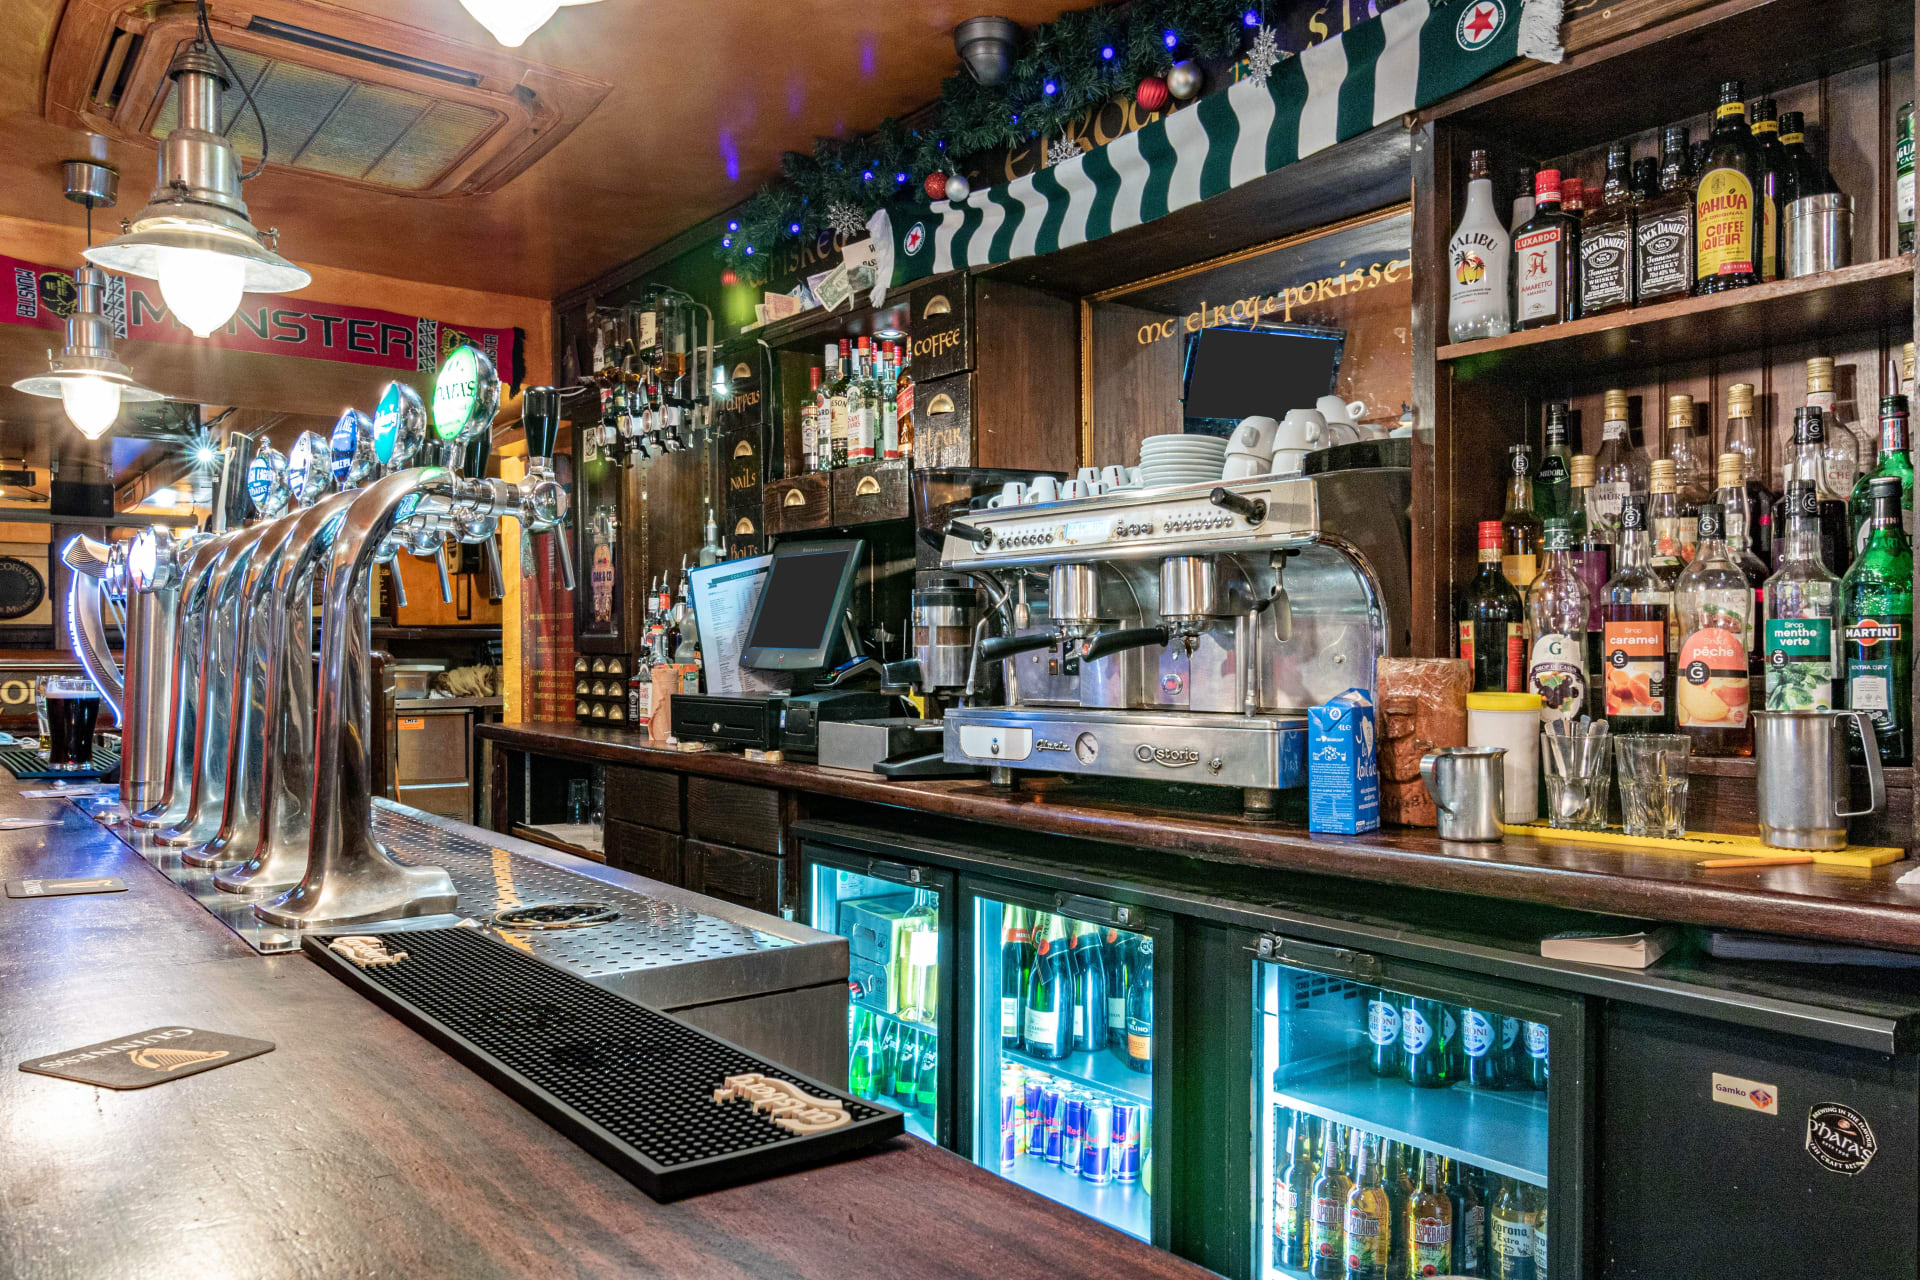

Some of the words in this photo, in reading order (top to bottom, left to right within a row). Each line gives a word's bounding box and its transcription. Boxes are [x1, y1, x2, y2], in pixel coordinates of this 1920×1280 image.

[1706, 221, 1744, 237] COFFEE
[1449, 232, 1498, 254] MALIBU
[1517, 232, 1557, 249] LUXARDO
[1639, 228, 1658, 246] JACK
[1581, 242, 1598, 260] JACK
[1646, 252, 1680, 264] Tennessee
[1646, 260, 1679, 272] WHISKEY
[1588, 274, 1618, 286] WHISKEY
[14, 266, 38, 318] MUNSTER
[1520, 280, 1552, 294] AMARETTO
[1263, 296, 1276, 315] &
[130, 289, 414, 359] MNSTER
[914, 327, 961, 358] COFFEE
[1540, 468, 1564, 478] MIDORI
[1784, 622, 1804, 630] Sirop
[1610, 634, 1659, 645] caramel
[1774, 628, 1818, 638] menthe
[1845, 628, 1898, 638] MARTINI
[1549, 642, 1562, 655] G
[1780, 638, 1810, 646] verte
[1613, 654, 1624, 664] G
[1692, 646, 1734, 659] pêche
[1773, 654, 1784, 664] G
[1690, 666, 1704, 679] G
[1404, 1024, 1425, 1035] RONI
[1464, 1026, 1488, 1036] RONI
[39, 1028, 194, 1070] GUINNESS
[1716, 1083, 1746, 1098] Gamko
[1847, 1112, 1860, 1123] THE
[1820, 1155, 1842, 1169] CRAFT
[1492, 1220, 1528, 1236] Corona
[1497, 1234, 1518, 1246] Extra
